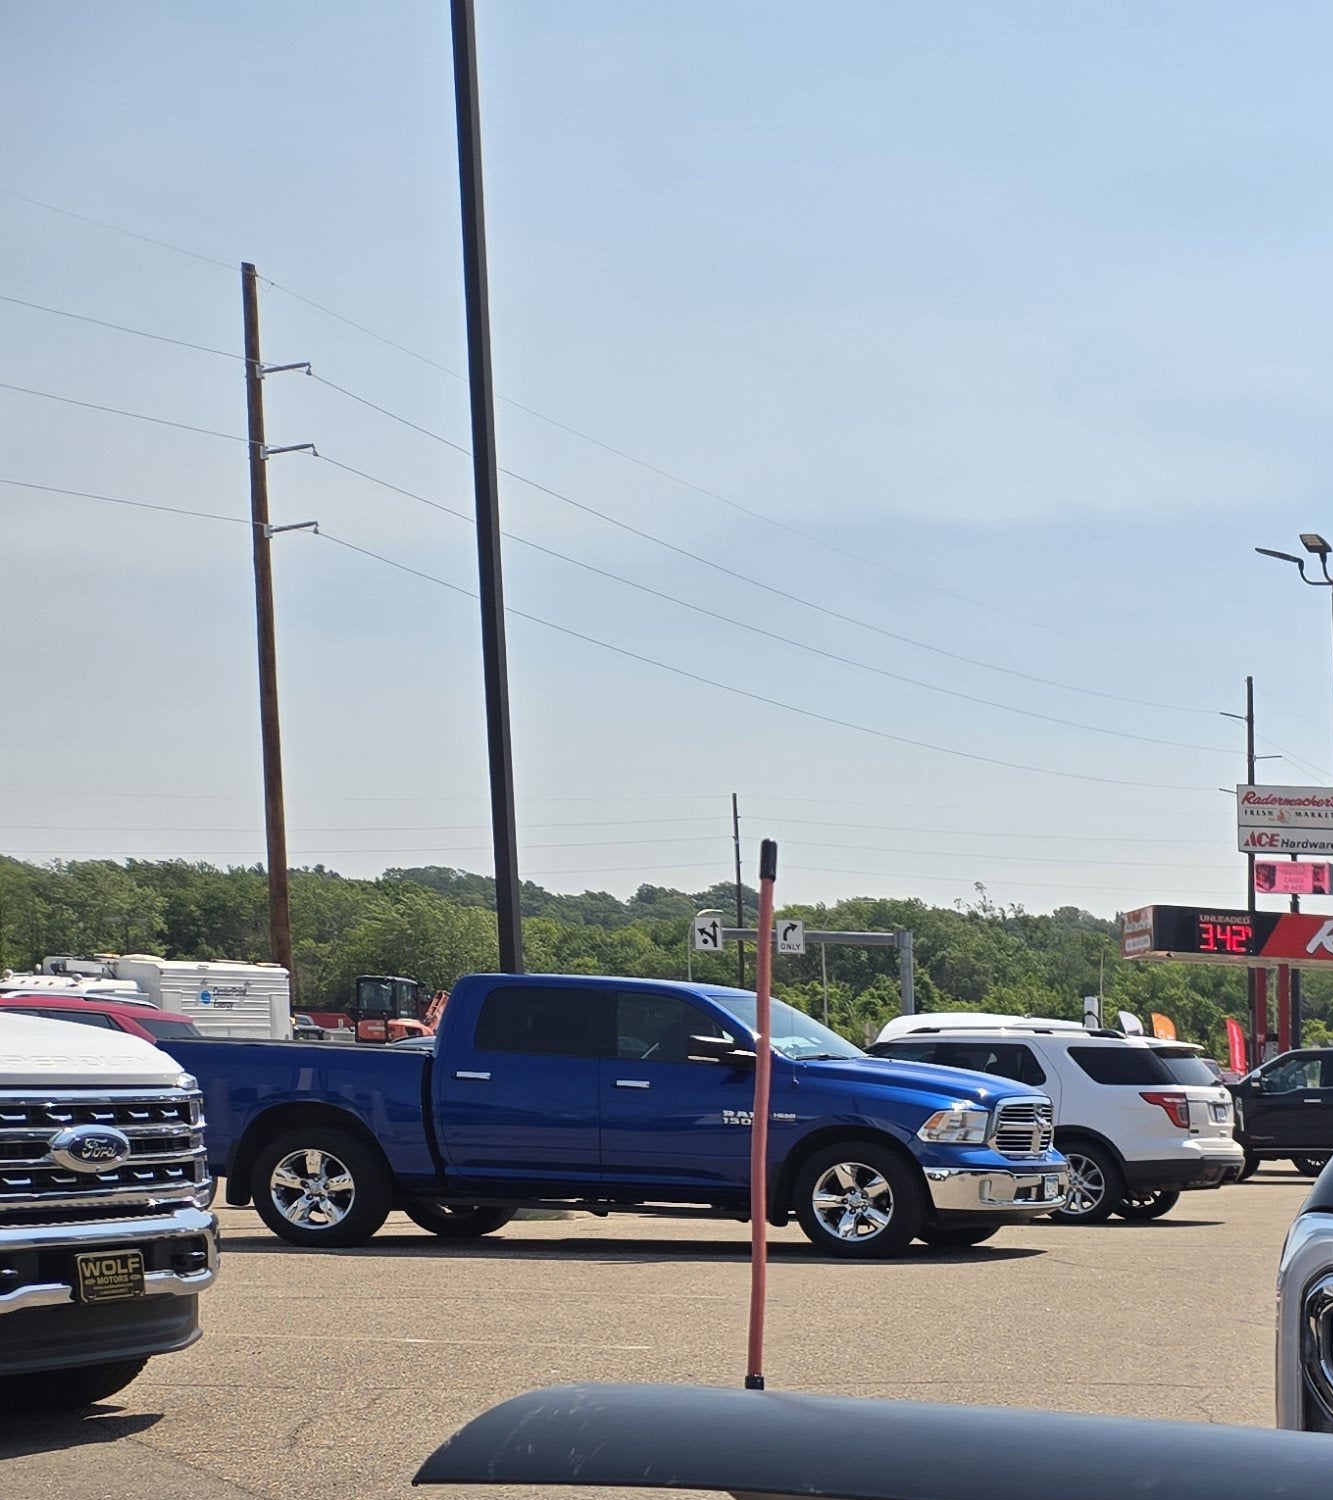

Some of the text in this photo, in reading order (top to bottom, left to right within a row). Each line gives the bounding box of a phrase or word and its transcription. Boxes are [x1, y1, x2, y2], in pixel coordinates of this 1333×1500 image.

[1243, 831, 1280, 847] ACE
[1200, 915, 1251, 924] UNLEADED
[781, 943, 800, 951] ONLY
[82, 1138, 117, 1159] Ford
[81, 1257, 140, 1278] WOLF
[97, 1275, 129, 1284] MOTORS
